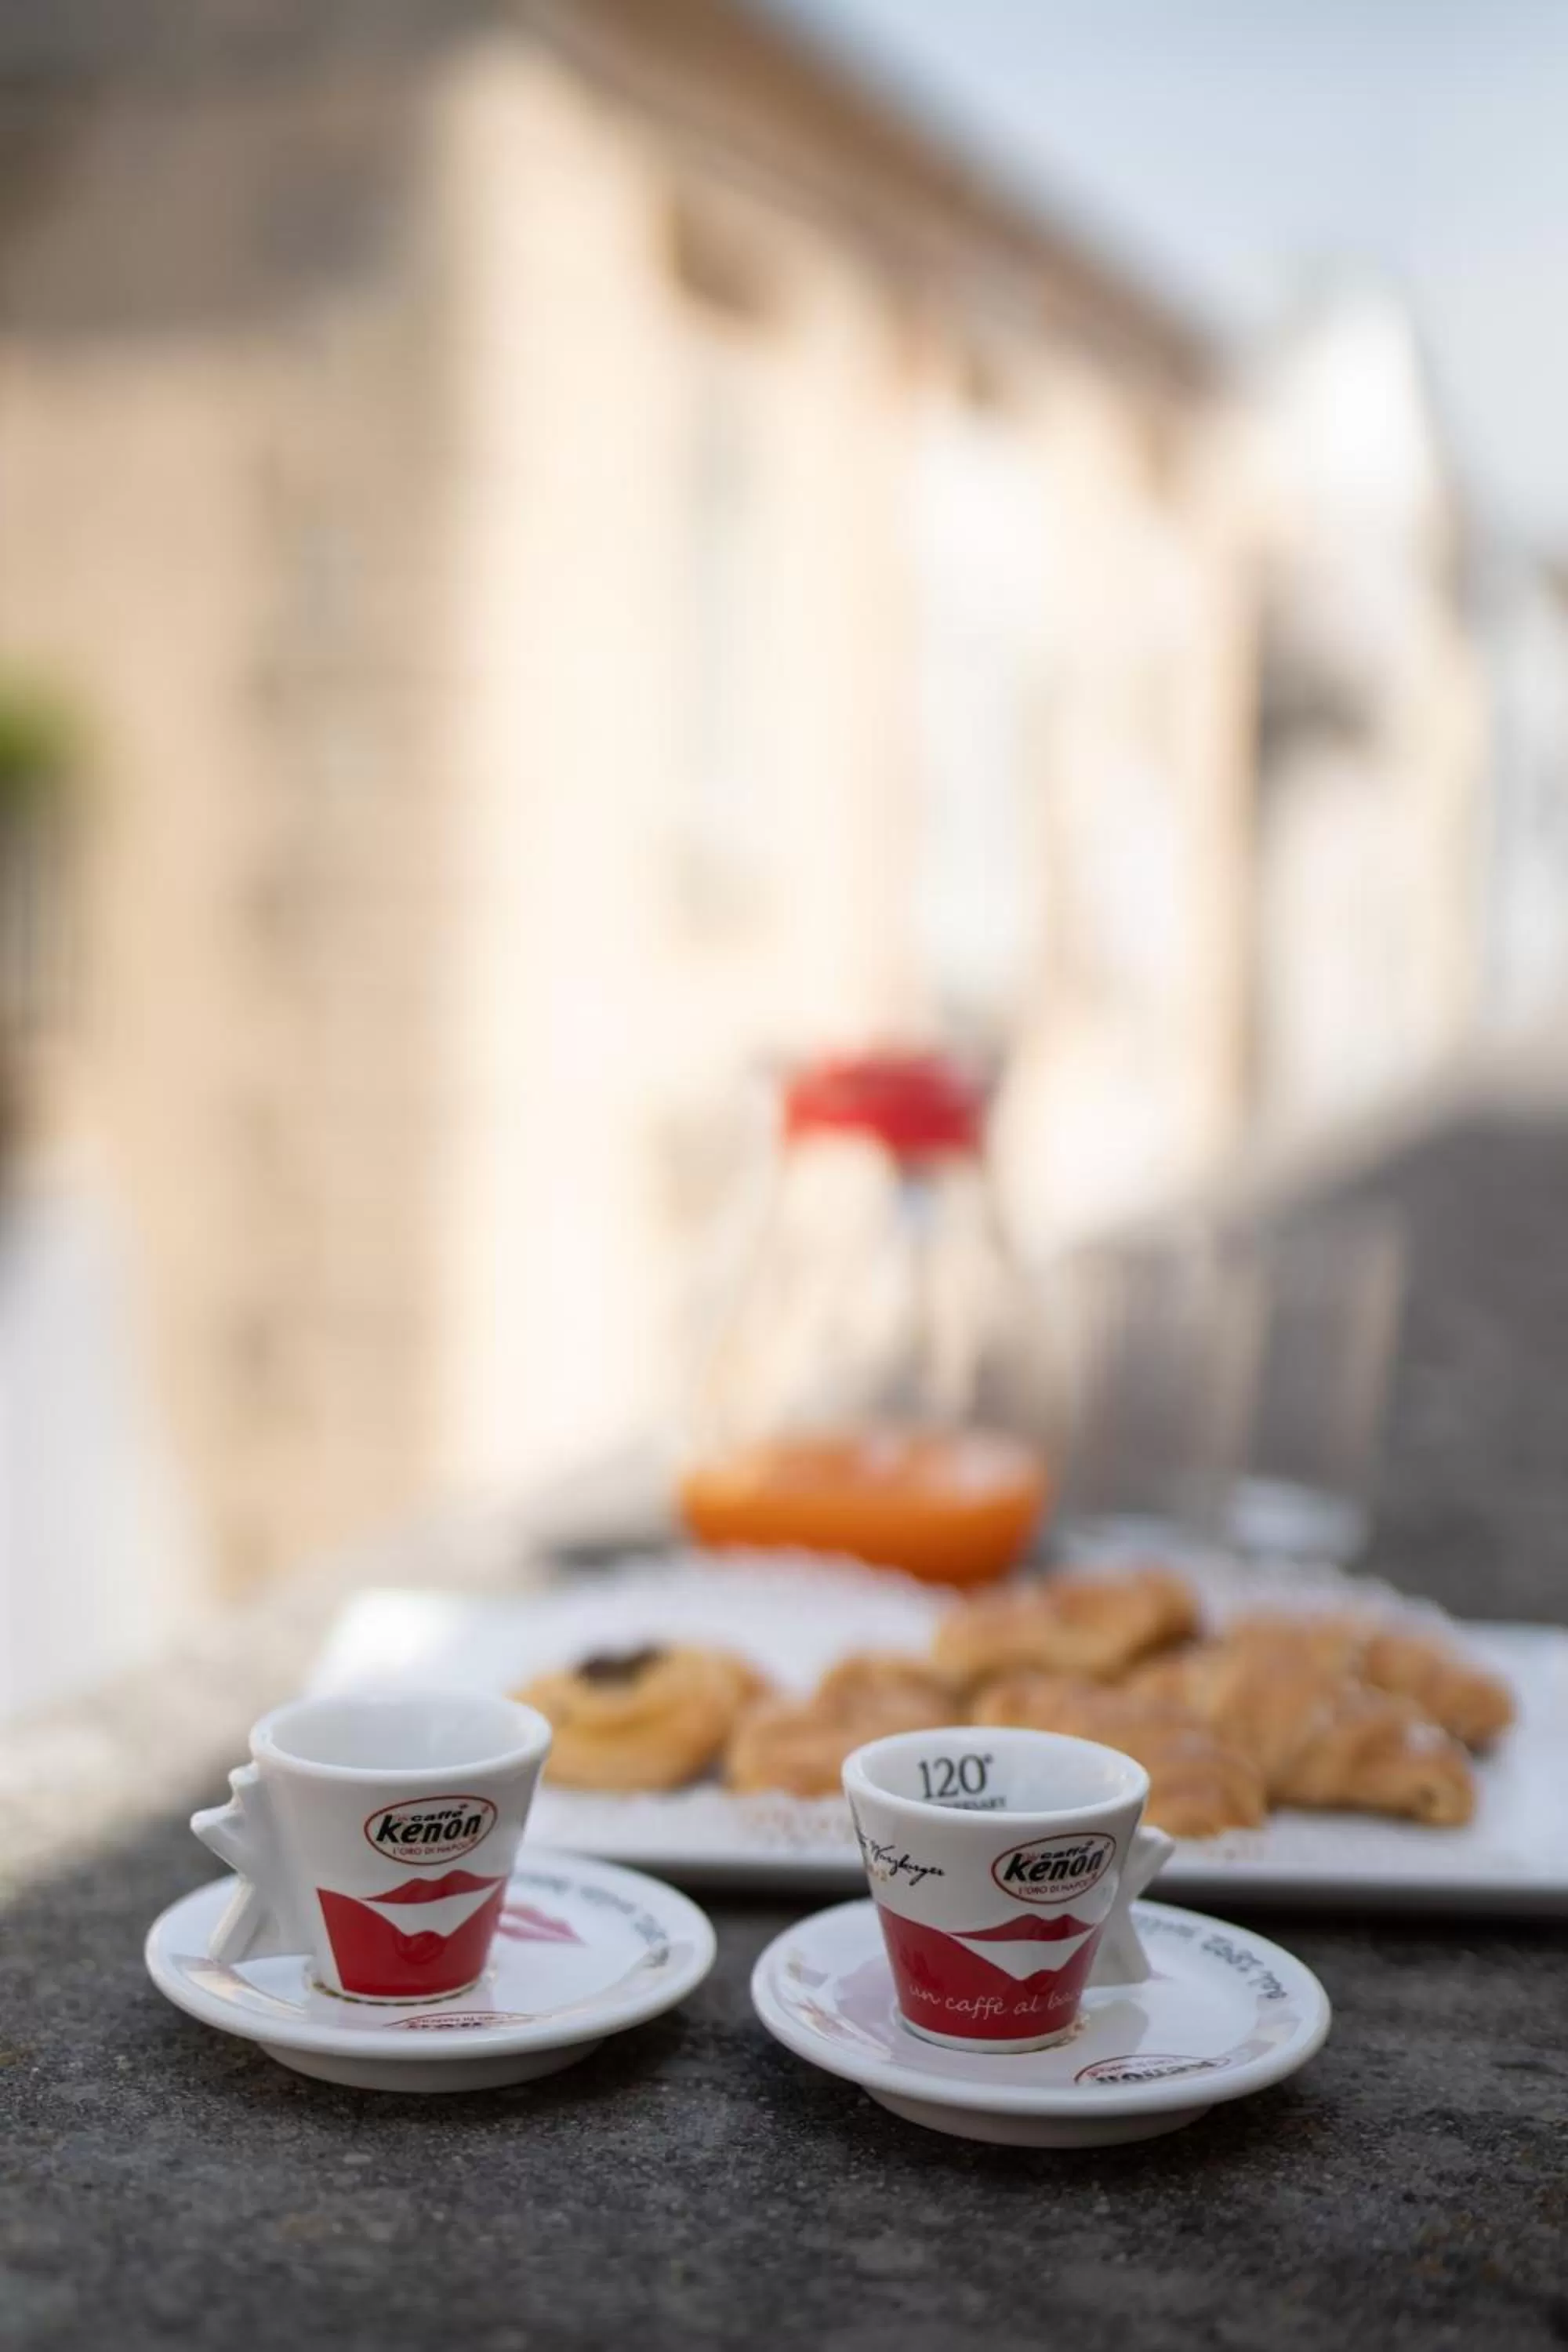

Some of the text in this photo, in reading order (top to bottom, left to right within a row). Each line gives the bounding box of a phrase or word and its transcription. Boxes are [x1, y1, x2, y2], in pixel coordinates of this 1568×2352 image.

[376, 1813, 481, 1843] kenon
[1004, 1849, 1104, 1882] kenon
[909, 1985, 941, 2005] un
[1013, 1994, 1039, 2016] al
